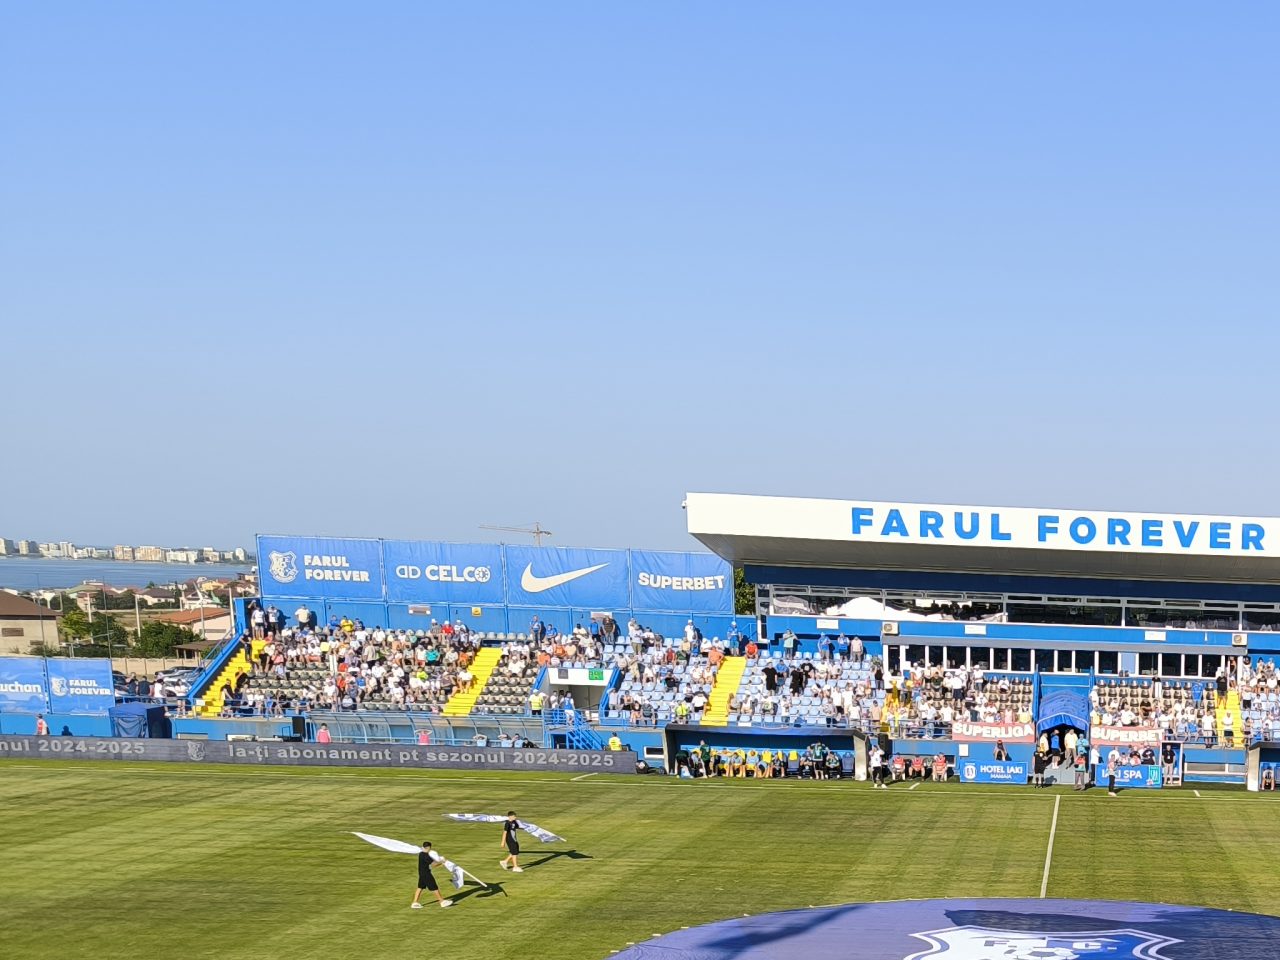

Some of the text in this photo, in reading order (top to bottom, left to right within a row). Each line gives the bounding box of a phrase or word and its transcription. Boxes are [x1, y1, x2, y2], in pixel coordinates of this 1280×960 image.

[851, 507, 1265, 550] FARUL FOREVER
[303, 555, 349, 567] FARUL
[305, 569, 370, 582] FOREVER
[425, 564, 490, 583] CELCO
[638, 572, 724, 590] SUPERBET
[69, 679, 98, 687] FARUL
[69, 687, 112, 696] FOREVER
[1091, 728, 1164, 743] SUPERBET
[38, 739, 145, 754] 2024-2025
[277, 746, 392, 761] abonament
[400, 749, 419, 764] pt
[426, 750, 505, 764] sezonul
[513, 751, 614, 767] 2024-2025
[980, 765, 1004, 774] HOTEL
[1123, 769, 1142, 779] SPA
